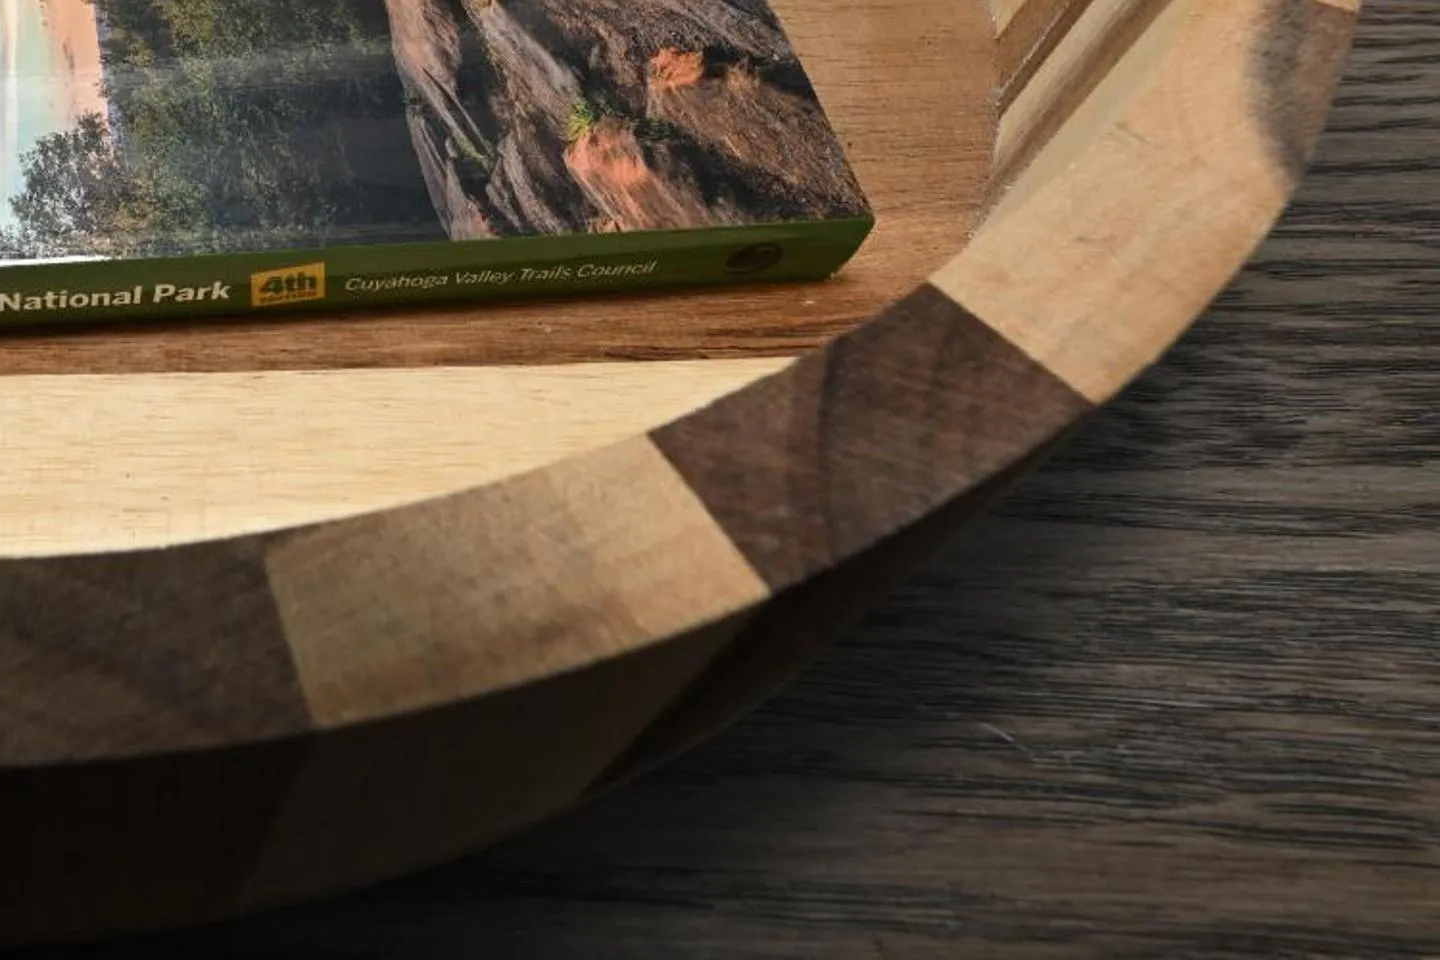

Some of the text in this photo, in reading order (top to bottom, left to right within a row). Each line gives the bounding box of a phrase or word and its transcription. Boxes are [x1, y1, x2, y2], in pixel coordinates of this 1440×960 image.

[260, 271, 317, 294] 4th
[345, 260, 657, 291] Cuyahoga Valley Trails Council
[152, 280, 232, 304] Park
